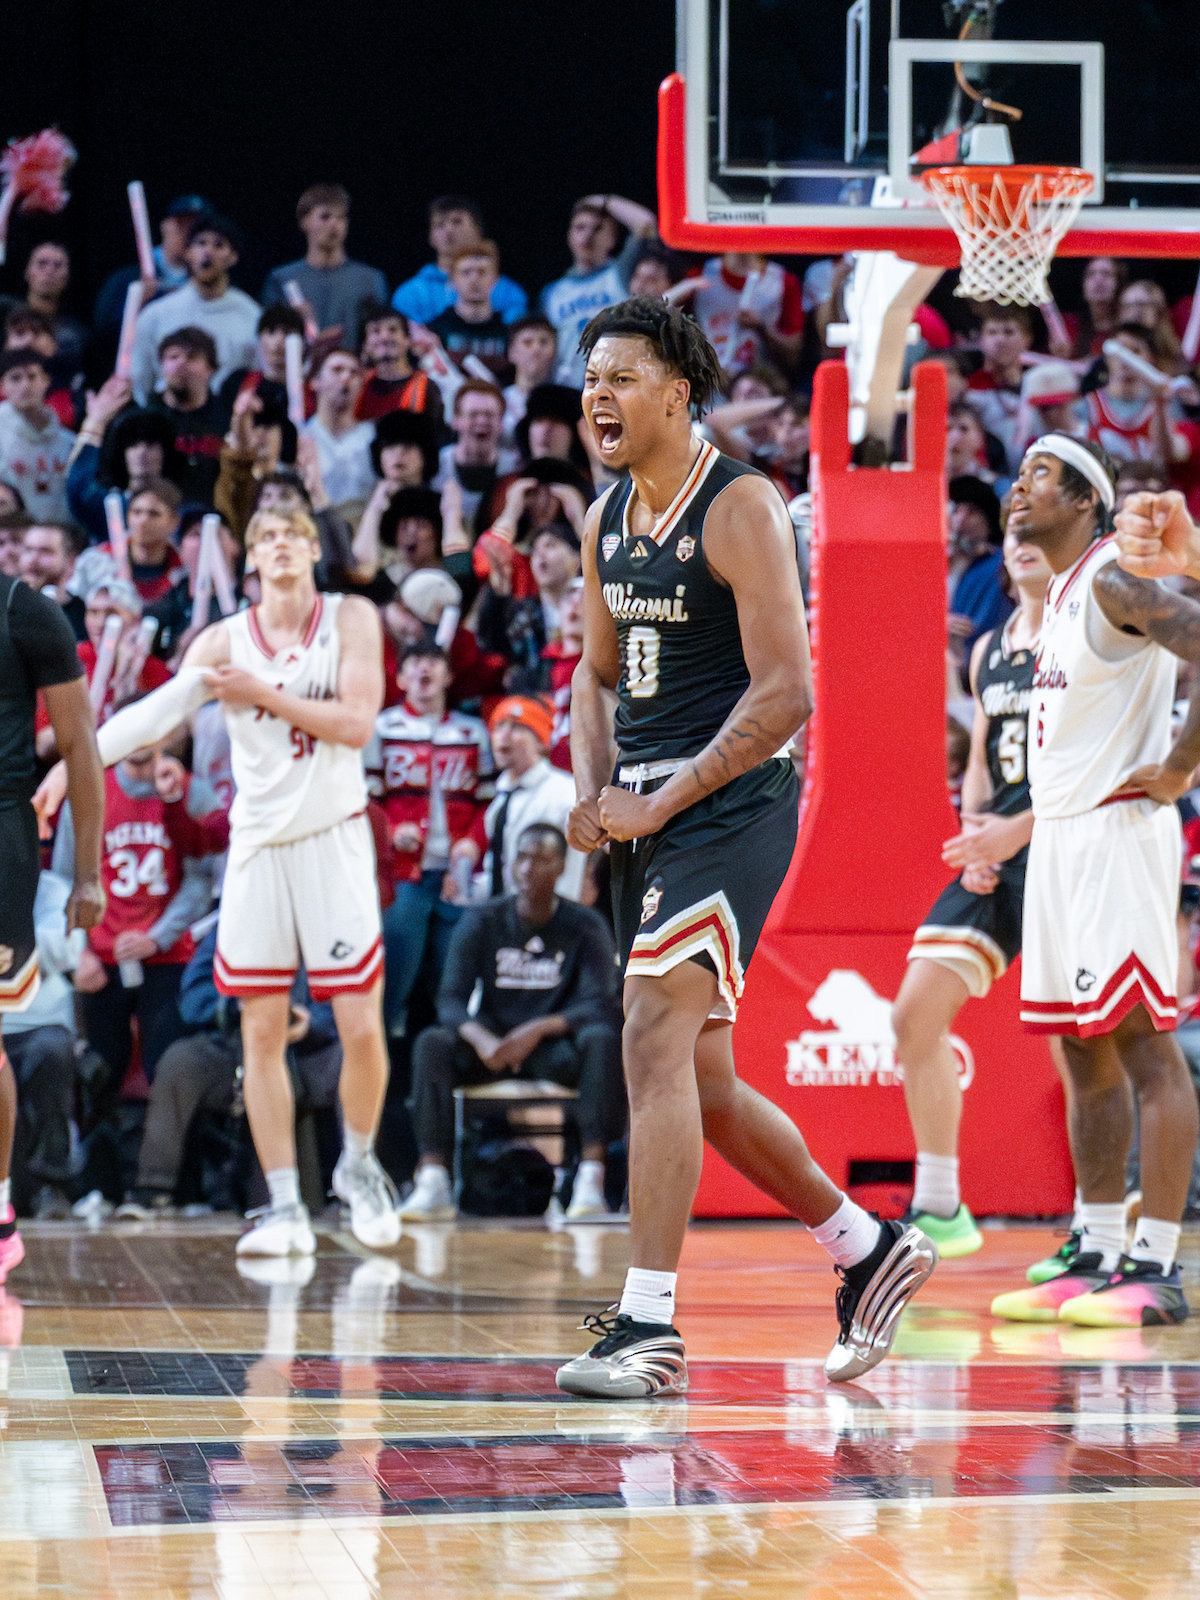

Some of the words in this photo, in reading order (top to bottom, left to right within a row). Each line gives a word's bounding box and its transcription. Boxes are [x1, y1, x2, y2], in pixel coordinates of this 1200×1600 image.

[602, 582, 689, 623] Miami
[626, 625, 662, 698] 0
[998, 718, 1026, 785] 5
[109, 848, 169, 897] 34
